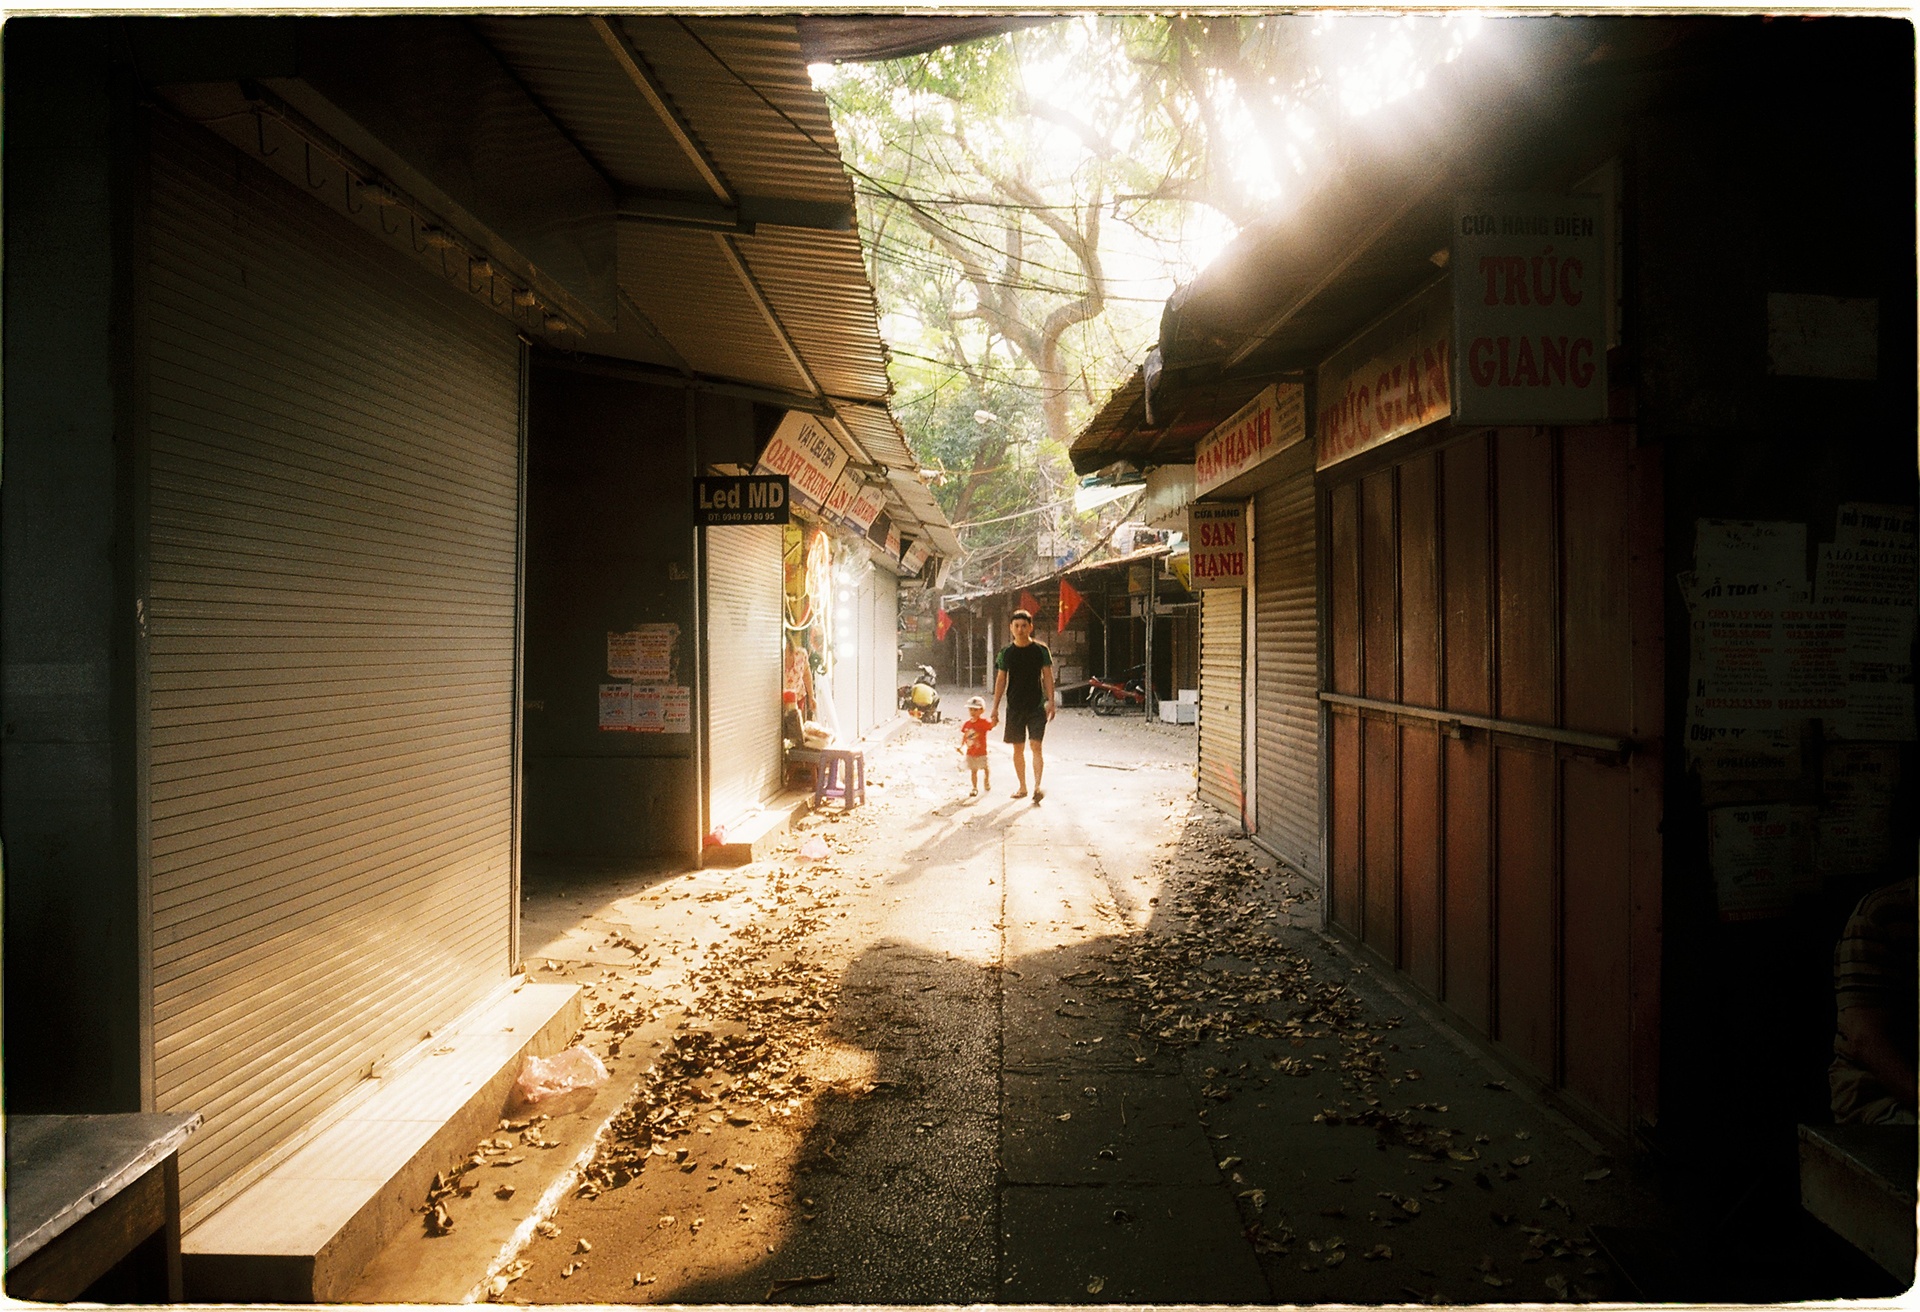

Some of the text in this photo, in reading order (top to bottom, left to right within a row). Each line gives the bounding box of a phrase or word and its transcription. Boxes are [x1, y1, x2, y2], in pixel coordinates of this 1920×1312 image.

[1479, 245, 1583, 306] TRÚC
[1469, 336, 1596, 388] GIANG
[1197, 441, 1223, 484] SAN
[1225, 407, 1271, 470] HẠNH
[1319, 381, 1370, 461] TRÚC
[700, 482, 740, 509] Led
[749, 482, 784, 508] MD
[766, 439, 805, 480] OANH
[798, 463, 832, 501] TRUNG
[722, 513, 741, 521] 0949
[754, 513, 763, 521] 80
[765, 512, 774, 520] 95
[1201, 523, 1236, 547] SAN
[1194, 552, 1244, 581] HẠNH
